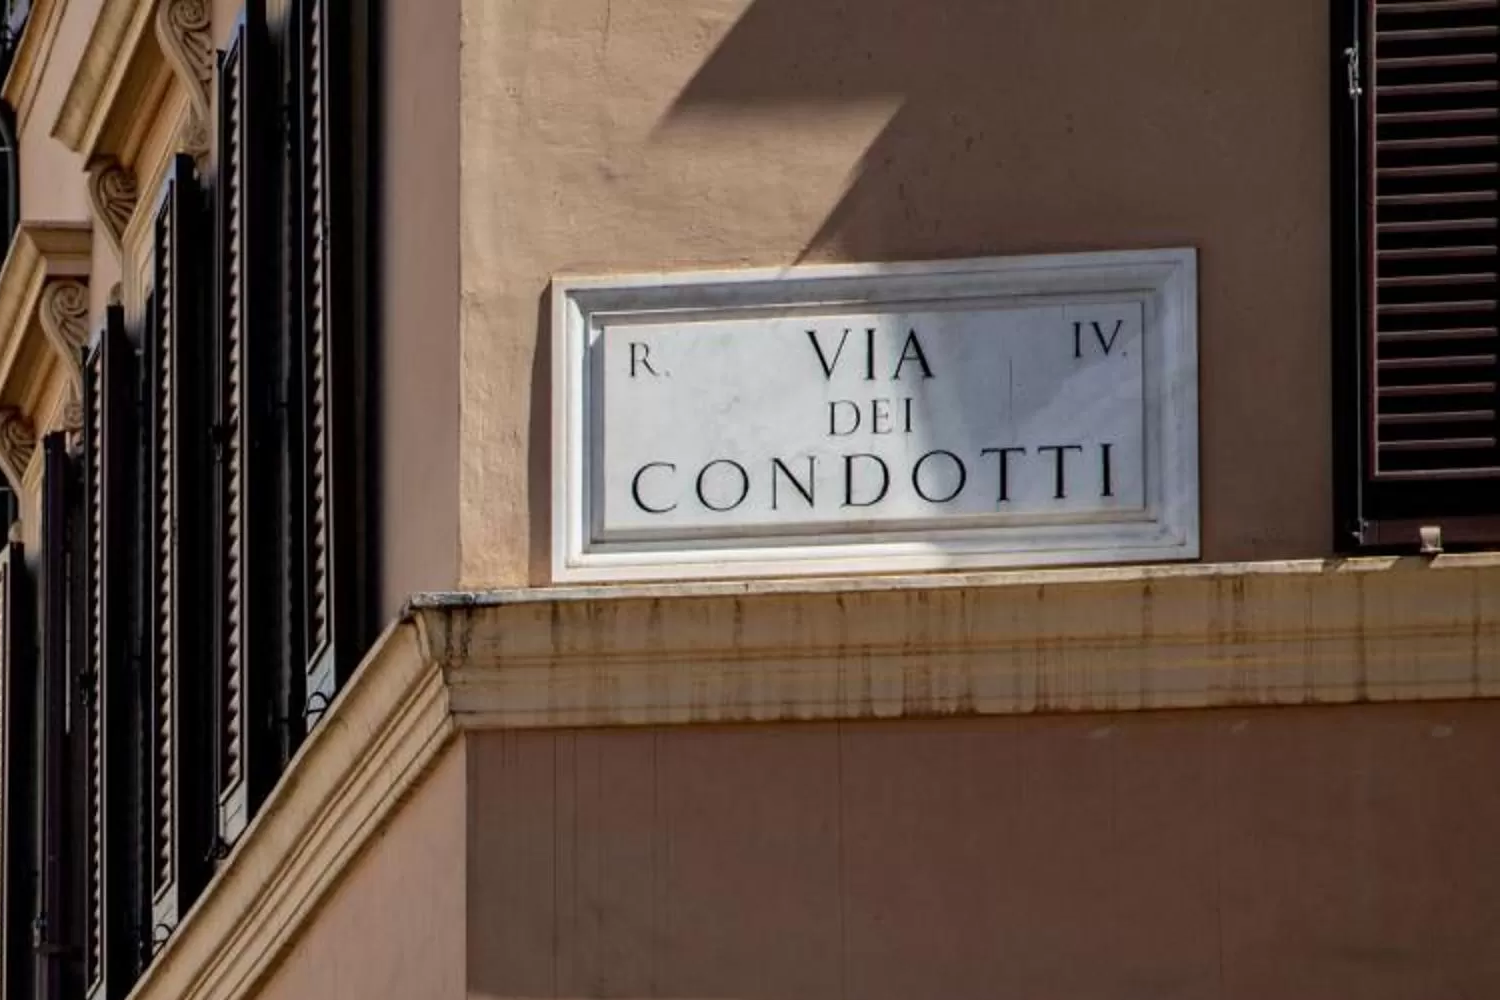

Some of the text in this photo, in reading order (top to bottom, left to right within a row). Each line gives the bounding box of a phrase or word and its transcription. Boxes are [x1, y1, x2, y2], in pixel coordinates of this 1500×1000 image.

[803, 327, 936, 382] VIA
[827, 398, 915, 437] DEI
[630, 443, 1116, 515] CONDOTTI
